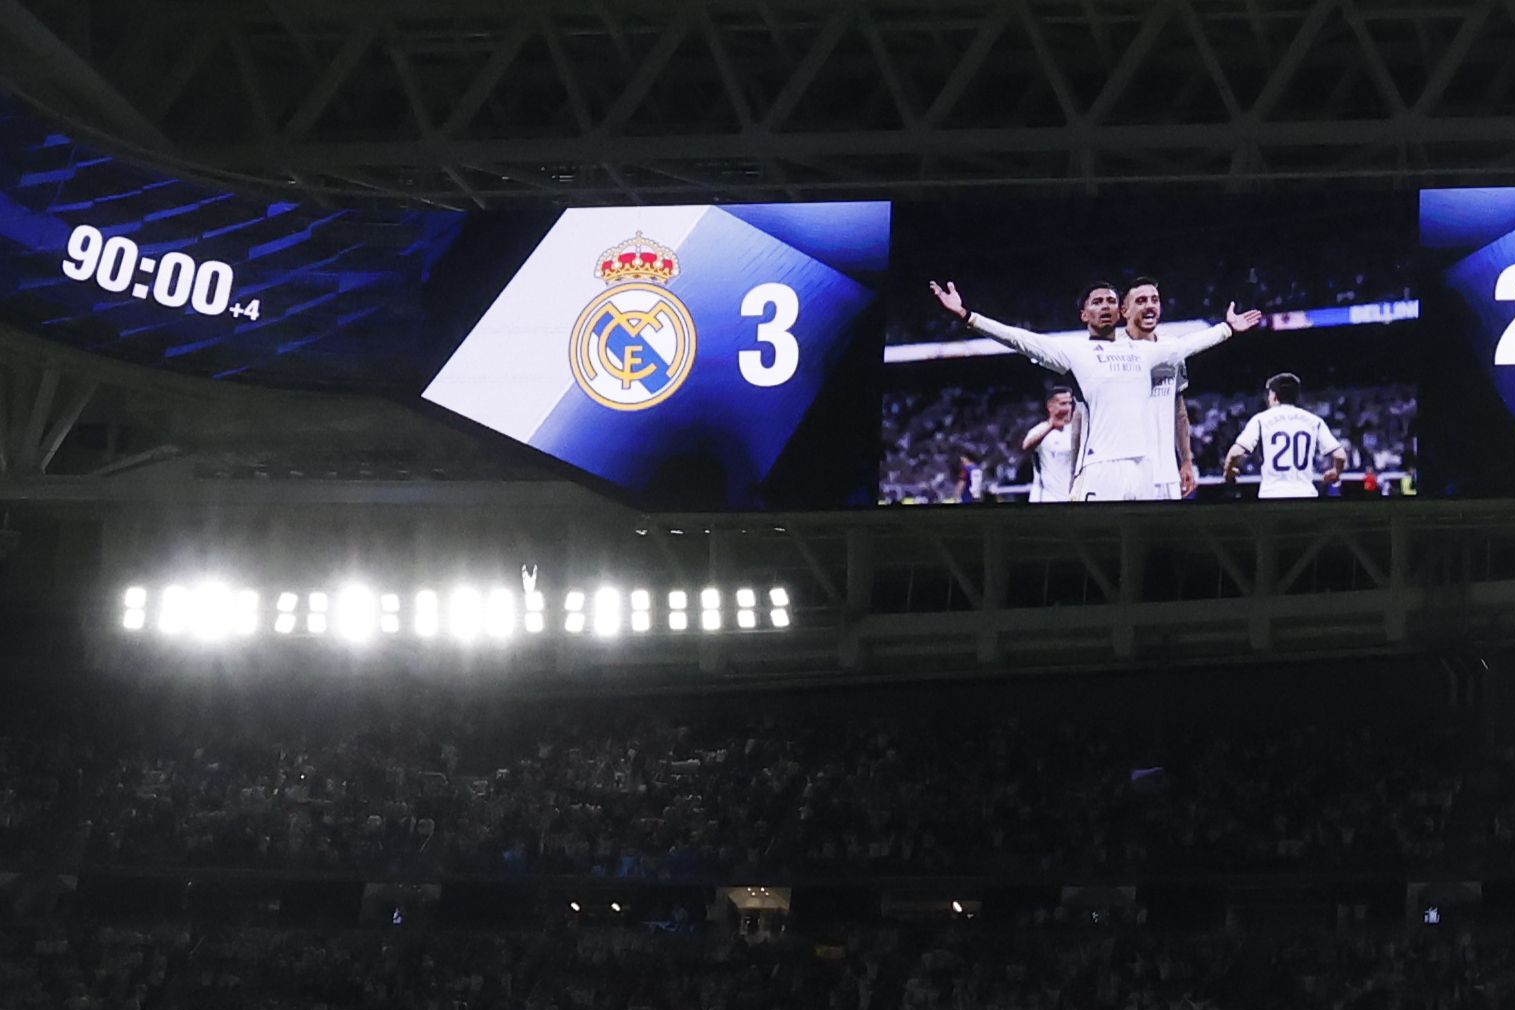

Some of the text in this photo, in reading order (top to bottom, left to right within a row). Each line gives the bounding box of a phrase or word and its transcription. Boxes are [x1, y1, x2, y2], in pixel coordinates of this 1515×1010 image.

[62, 225, 260, 321] 90:00 +4
[738, 282, 800, 387] 3
[1271, 430, 1312, 472] 20
